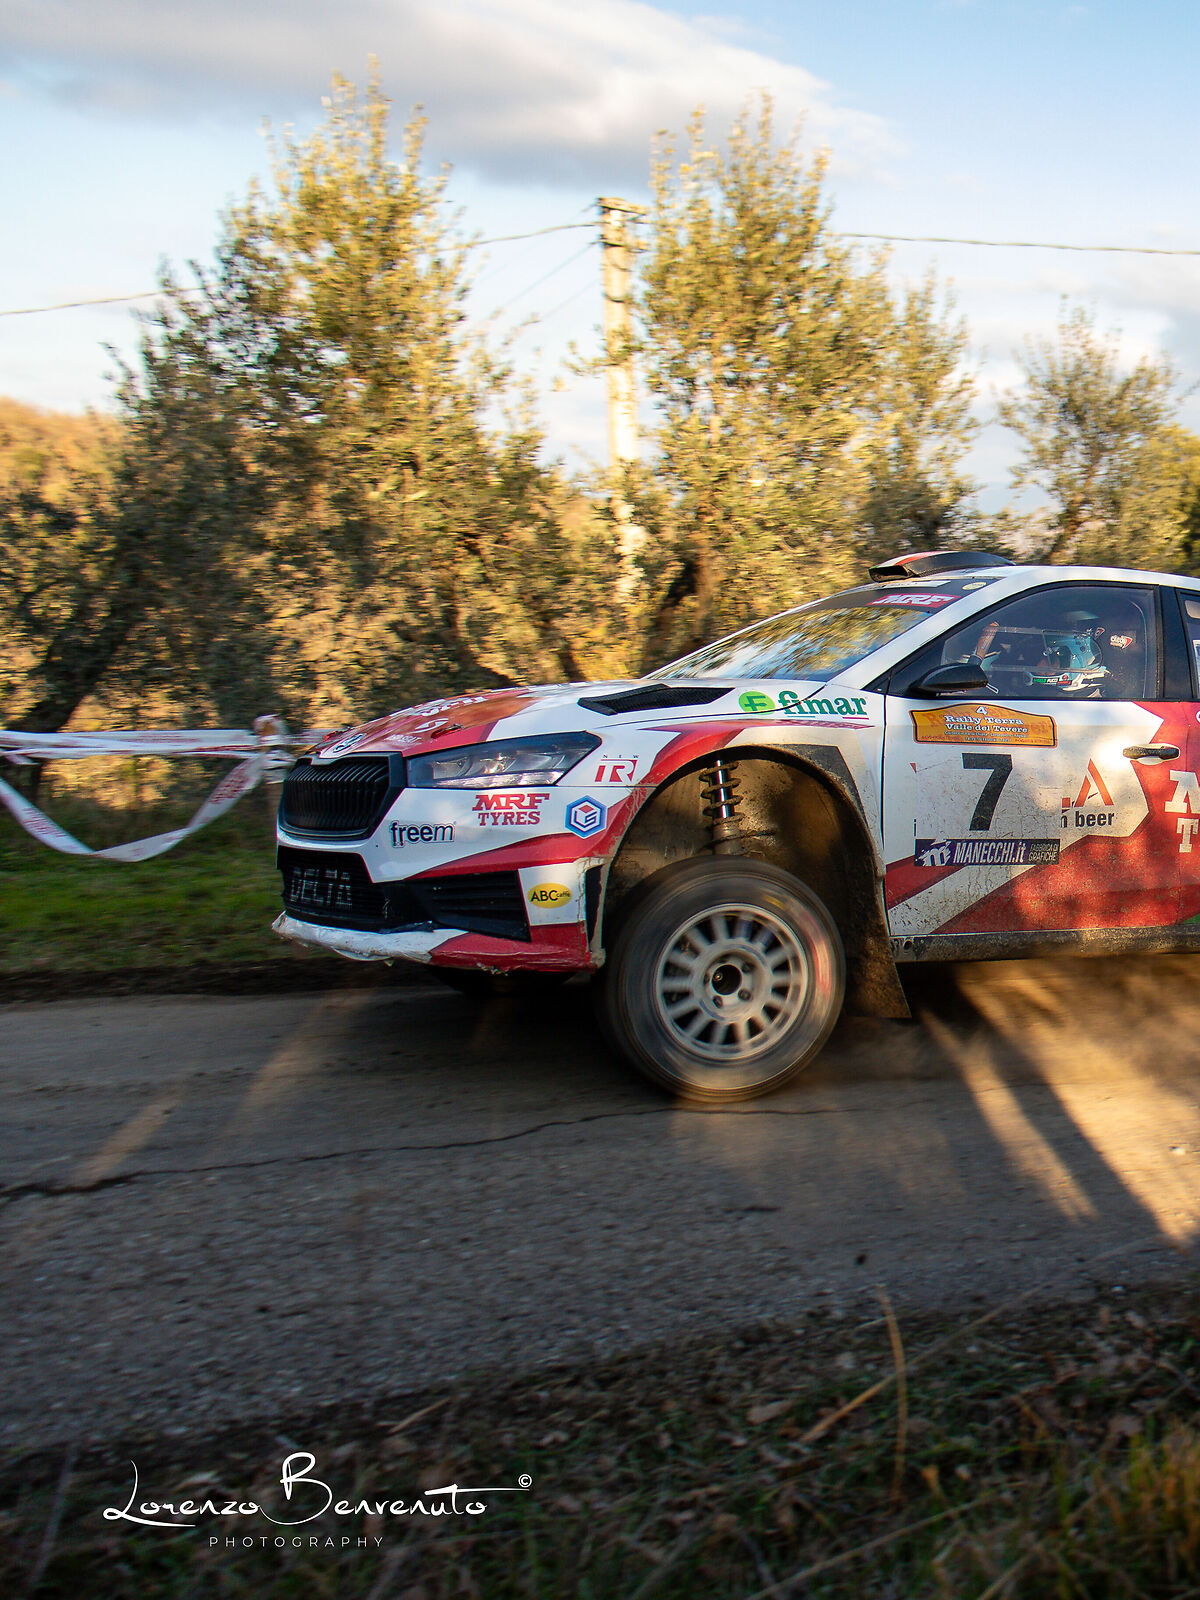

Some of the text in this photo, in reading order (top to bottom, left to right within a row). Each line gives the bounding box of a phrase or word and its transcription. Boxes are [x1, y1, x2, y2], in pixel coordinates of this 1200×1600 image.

[778, 690, 868, 716] fimar
[944, 715, 1024, 725] Rally Terra
[945, 723, 973, 731] Valle
[992, 725, 1028, 733] Tevere
[962, 753, 1013, 831] 7
[472, 793, 550, 811] MRF
[478, 811, 541, 826] TYRES
[1075, 811, 1114, 827] beer
[390, 820, 455, 847] freem
[953, 842, 1026, 864] MANECCHI.it
[531, 890, 558, 902] ABC
